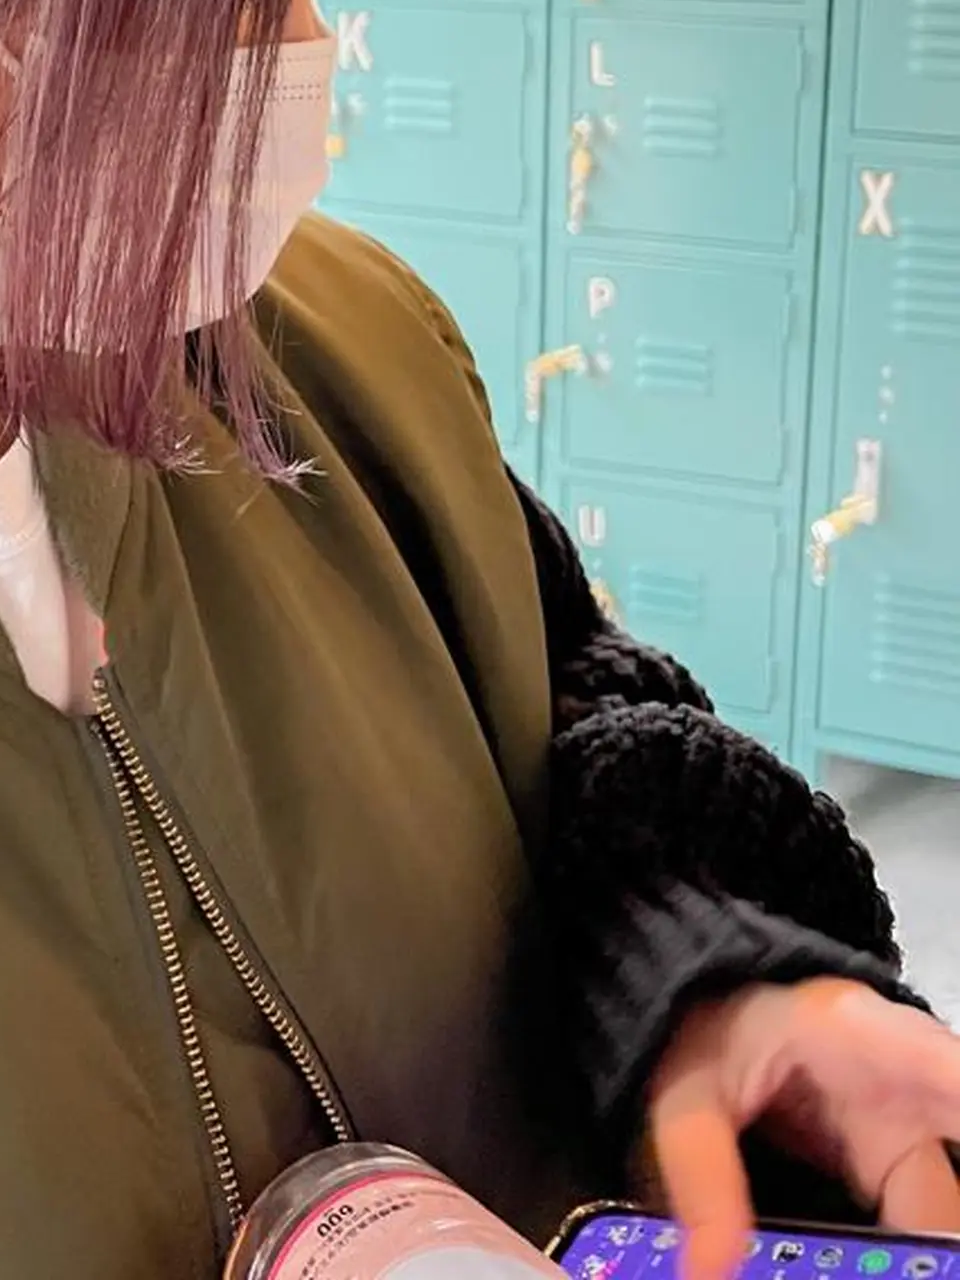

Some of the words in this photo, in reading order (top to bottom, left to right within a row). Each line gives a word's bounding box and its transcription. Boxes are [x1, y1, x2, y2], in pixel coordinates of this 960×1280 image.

[338, 11, 373, 72] K
[590, 41, 615, 86] L
[859, 171, 895, 237] X
[588, 277, 615, 318] P
[579, 505, 606, 546] U
